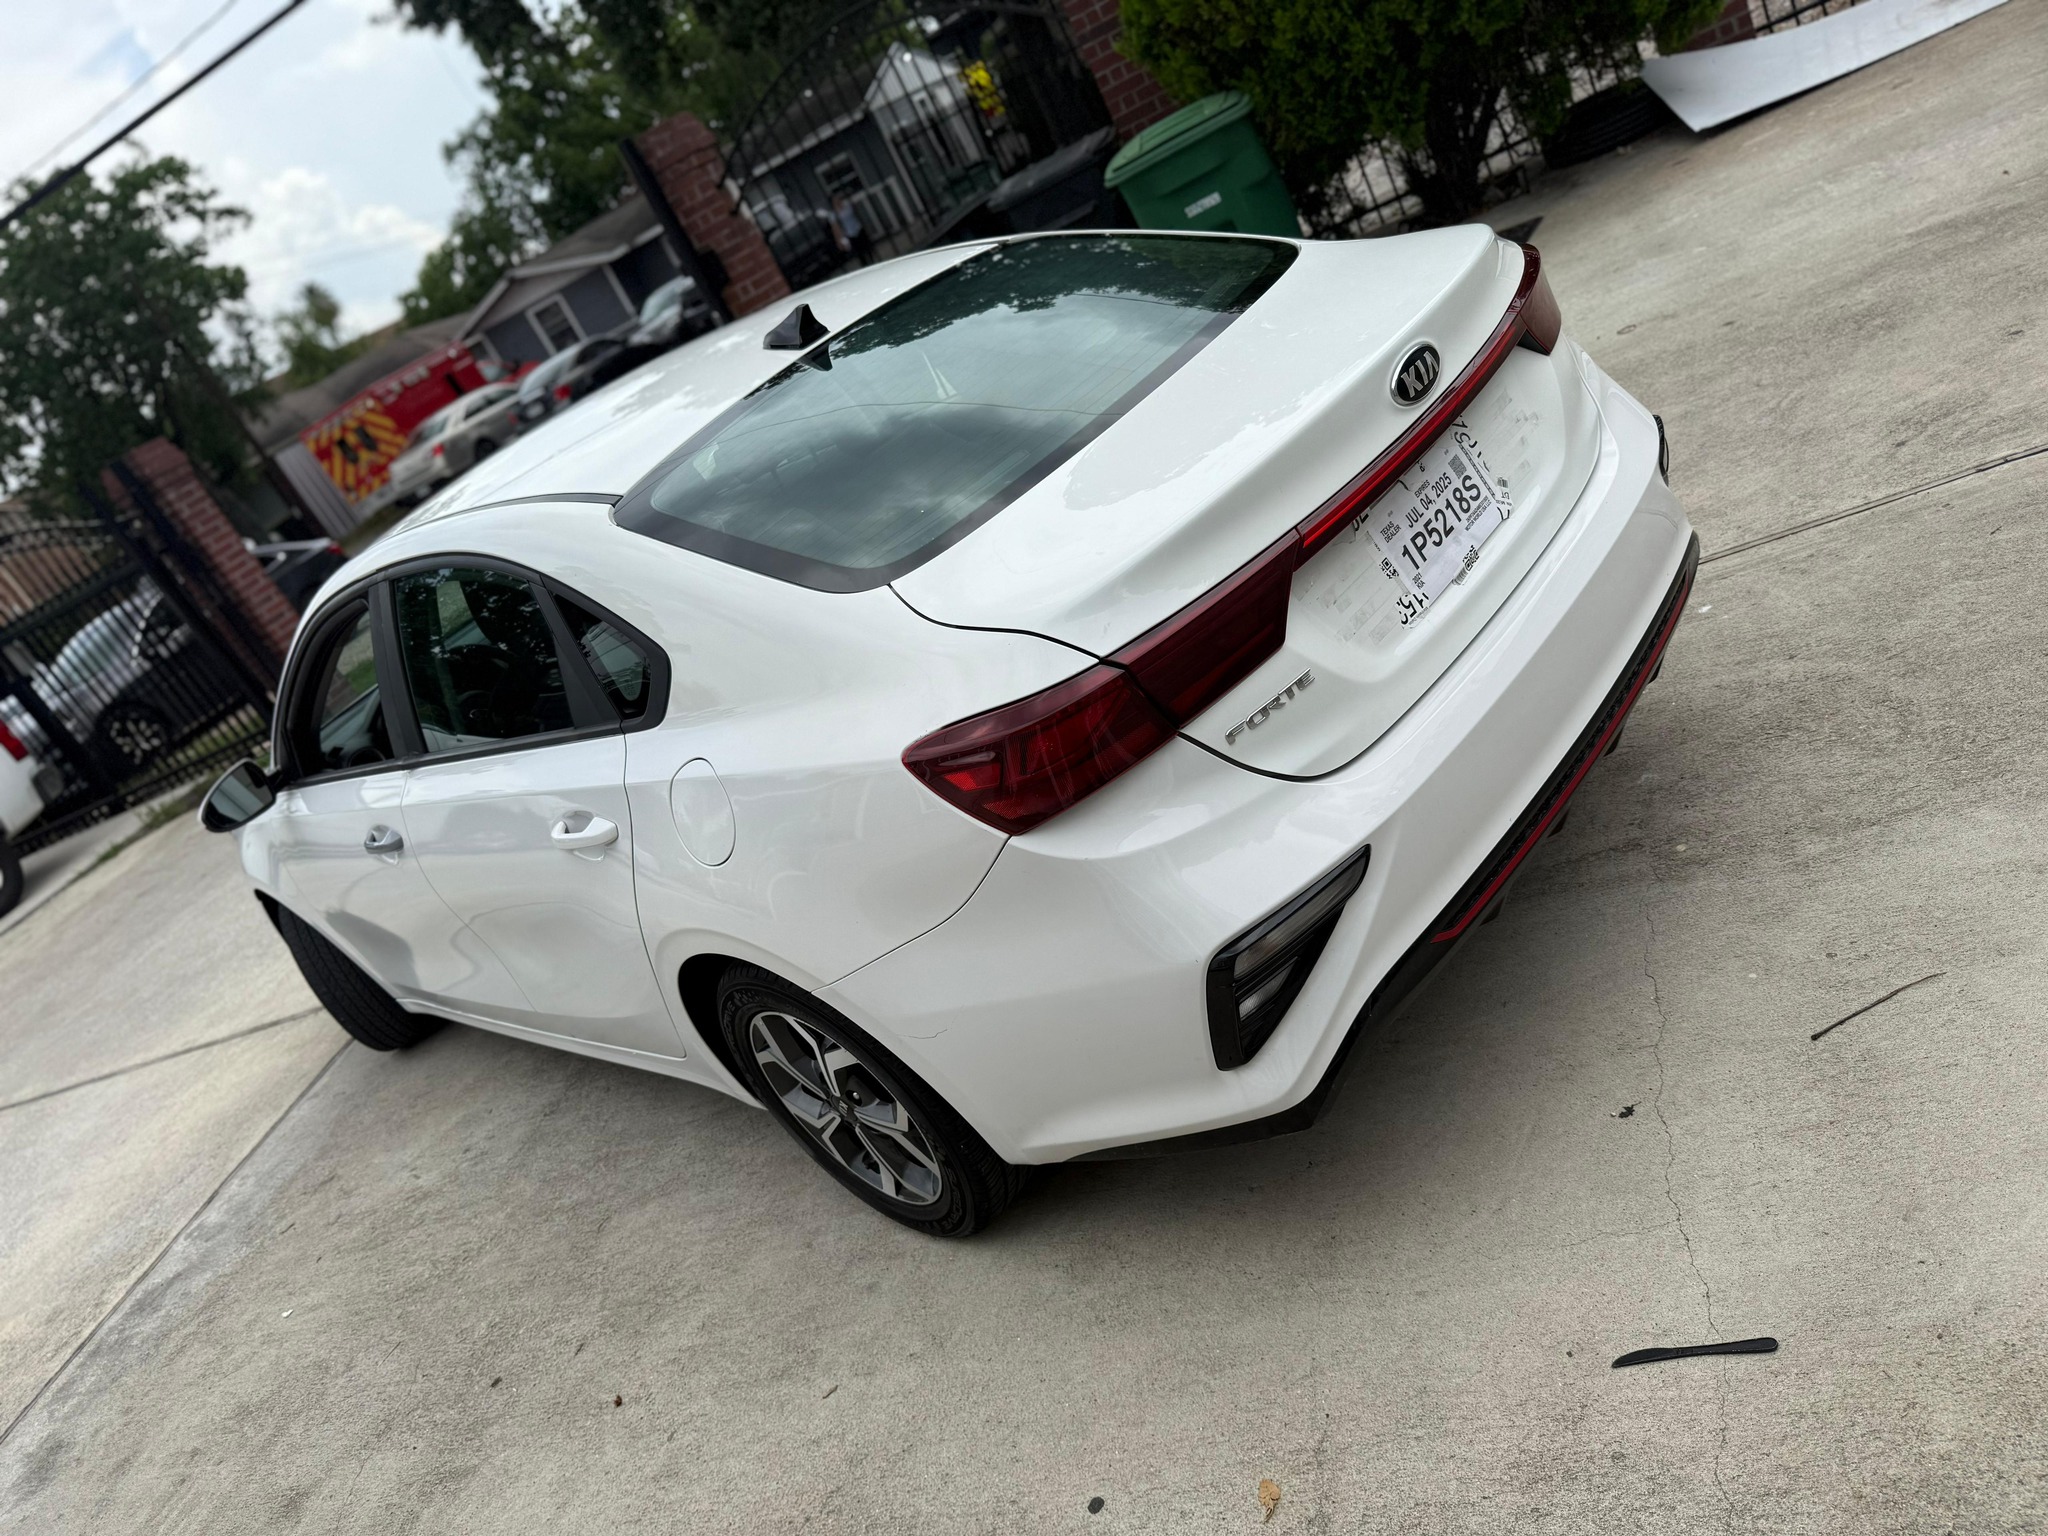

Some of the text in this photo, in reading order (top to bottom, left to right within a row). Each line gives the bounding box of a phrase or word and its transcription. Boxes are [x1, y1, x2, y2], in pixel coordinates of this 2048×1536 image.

[1401, 351, 1439, 398] KIA
[1405, 506, 1424, 528] JUL
[1420, 493, 1436, 510] 04,
[1431, 472, 1452, 499] 2025
[1414, 479, 1431, 498] EXPIRES
[1380, 521, 1397, 537] TEXAS
[1384, 525, 1402, 543] DEALER
[1402, 474, 1481, 571] 1P5218S
[1416, 580, 1426, 590] KIA
[1225, 667, 1316, 746] FORTE
